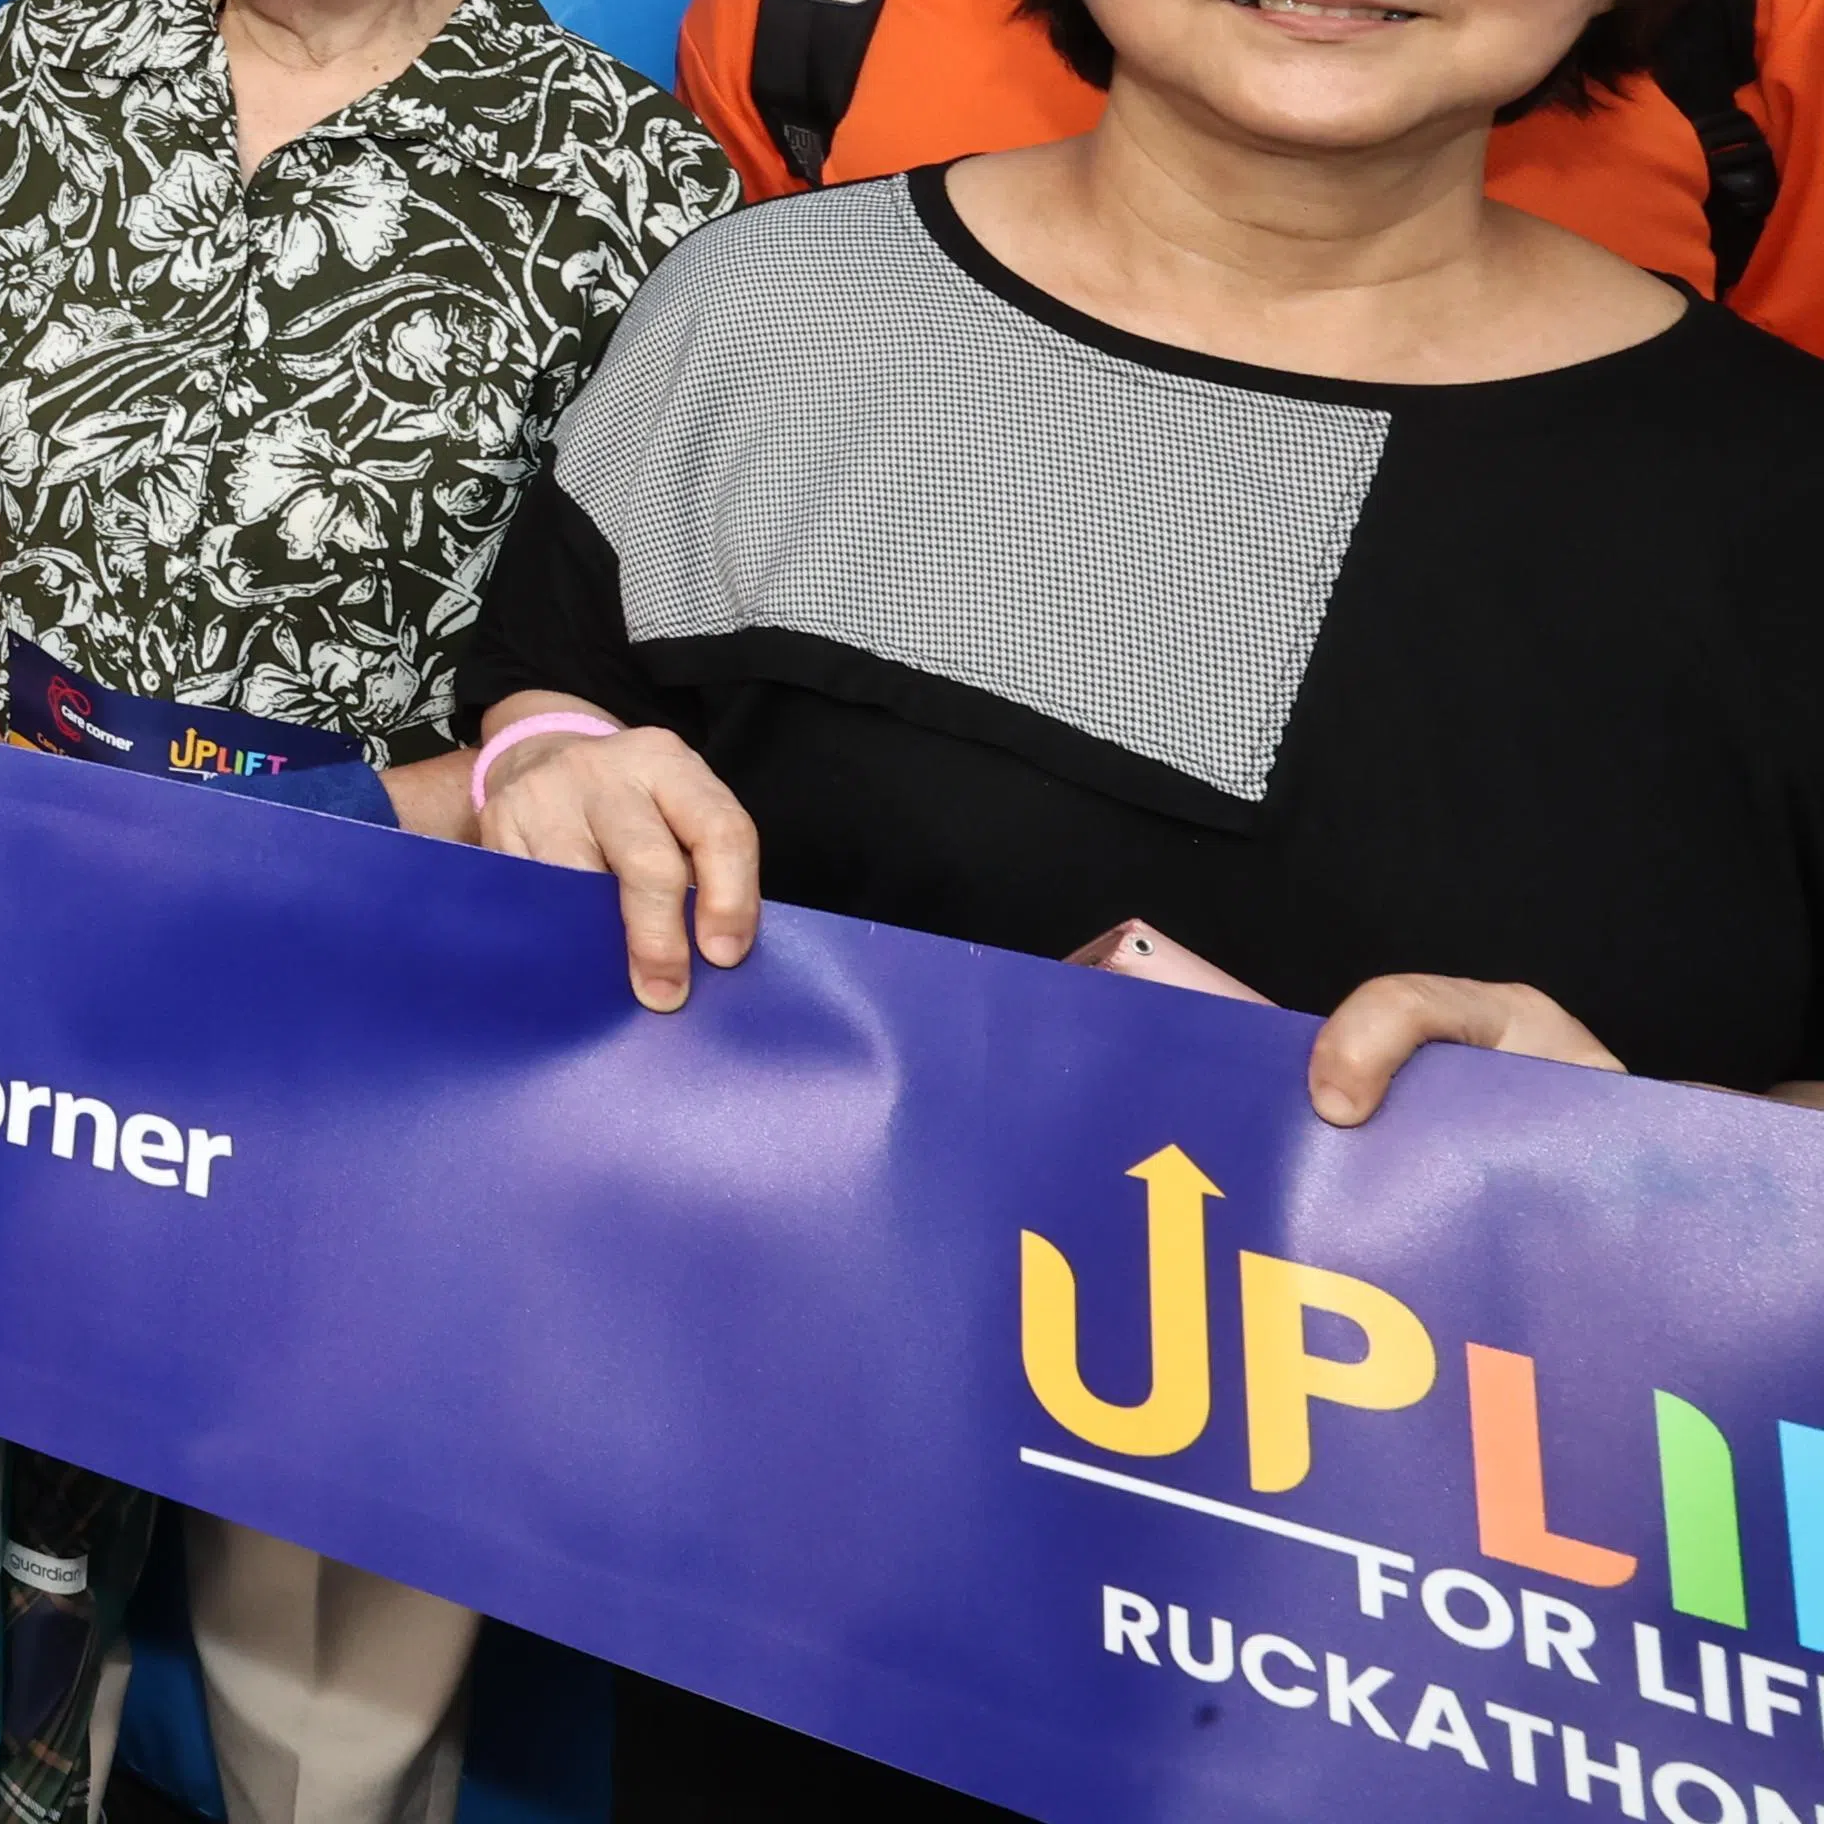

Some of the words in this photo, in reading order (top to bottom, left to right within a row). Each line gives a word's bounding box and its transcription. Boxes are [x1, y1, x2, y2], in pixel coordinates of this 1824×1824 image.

[61, 704, 86, 730] care
[86, 722, 134, 752] corner
[169, 728, 288, 777] UPLIFT
[1021, 1143, 1824, 1653] UPLI
[1354, 1548, 1600, 1684] FOR
[1632, 1620, 1824, 1748] LIF
